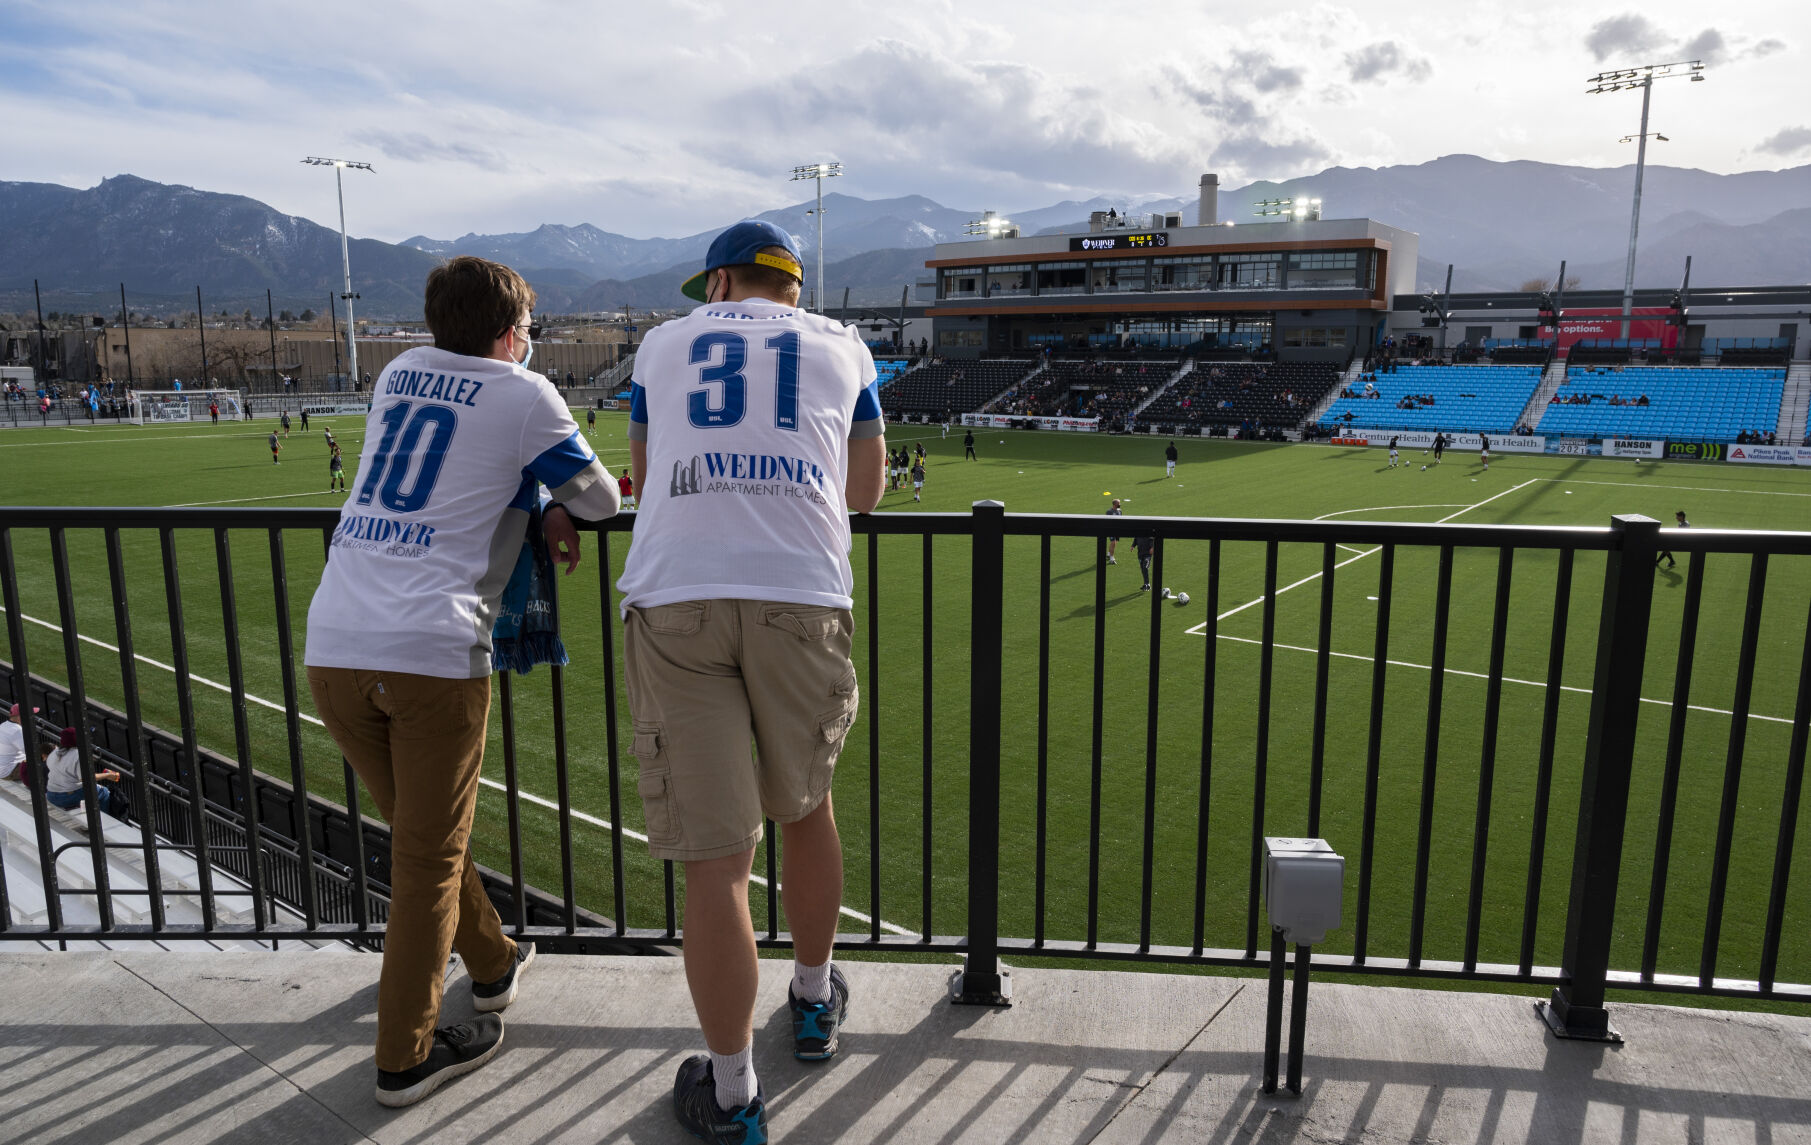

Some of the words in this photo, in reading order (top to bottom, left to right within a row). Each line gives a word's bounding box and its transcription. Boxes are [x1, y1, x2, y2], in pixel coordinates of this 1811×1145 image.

[1563, 325, 1604, 334] options.
[386, 370, 484, 407] GONZALEZ
[687, 331, 801, 432] 31
[1359, 432, 1392, 441] Centur
[1459, 436, 1500, 446] Centra
[1614, 440, 1652, 449] HANSON
[356, 400, 459, 513] 10
[1669, 443, 1697, 454] me
[705, 452, 825, 491] WEIDNER
[706, 482, 782, 497] APARTMENT
[785, 486, 827, 505] HOMES
[342, 515, 436, 547] WEIDNER
